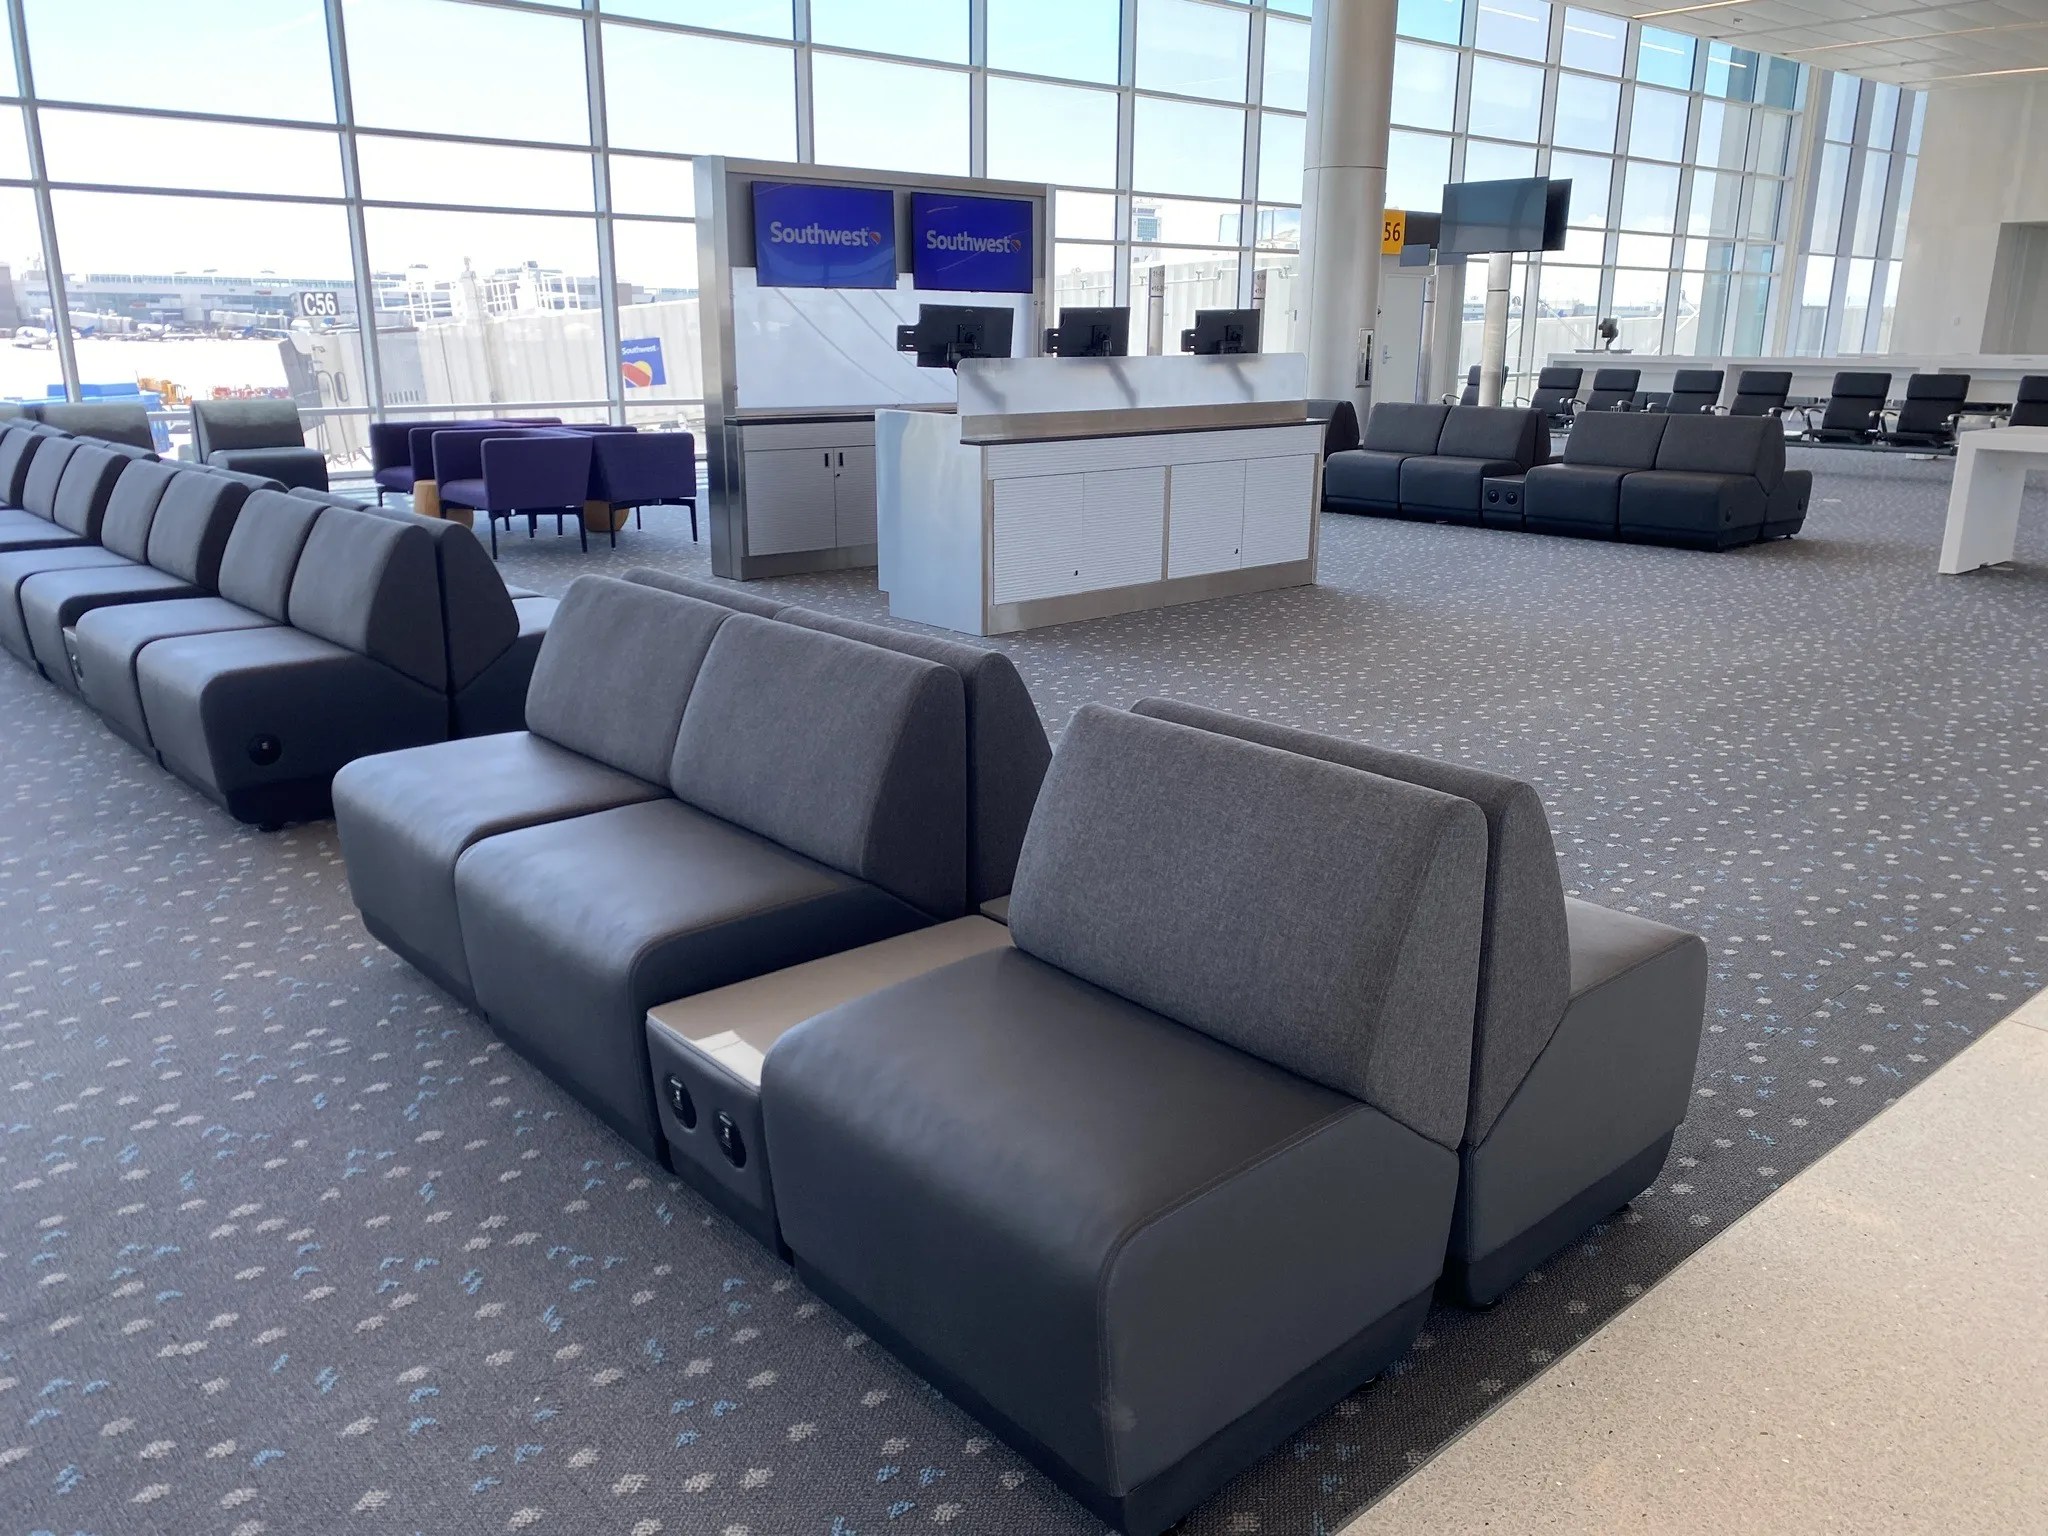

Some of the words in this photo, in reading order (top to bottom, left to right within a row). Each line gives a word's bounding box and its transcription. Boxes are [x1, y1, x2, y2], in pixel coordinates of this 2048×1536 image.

[769, 221, 869, 247] Southwest
[926, 230, 1011, 253] Southwest
[1384, 221, 1401, 242] 56
[303, 292, 336, 316] C56
[621, 344, 657, 355] Southwest
